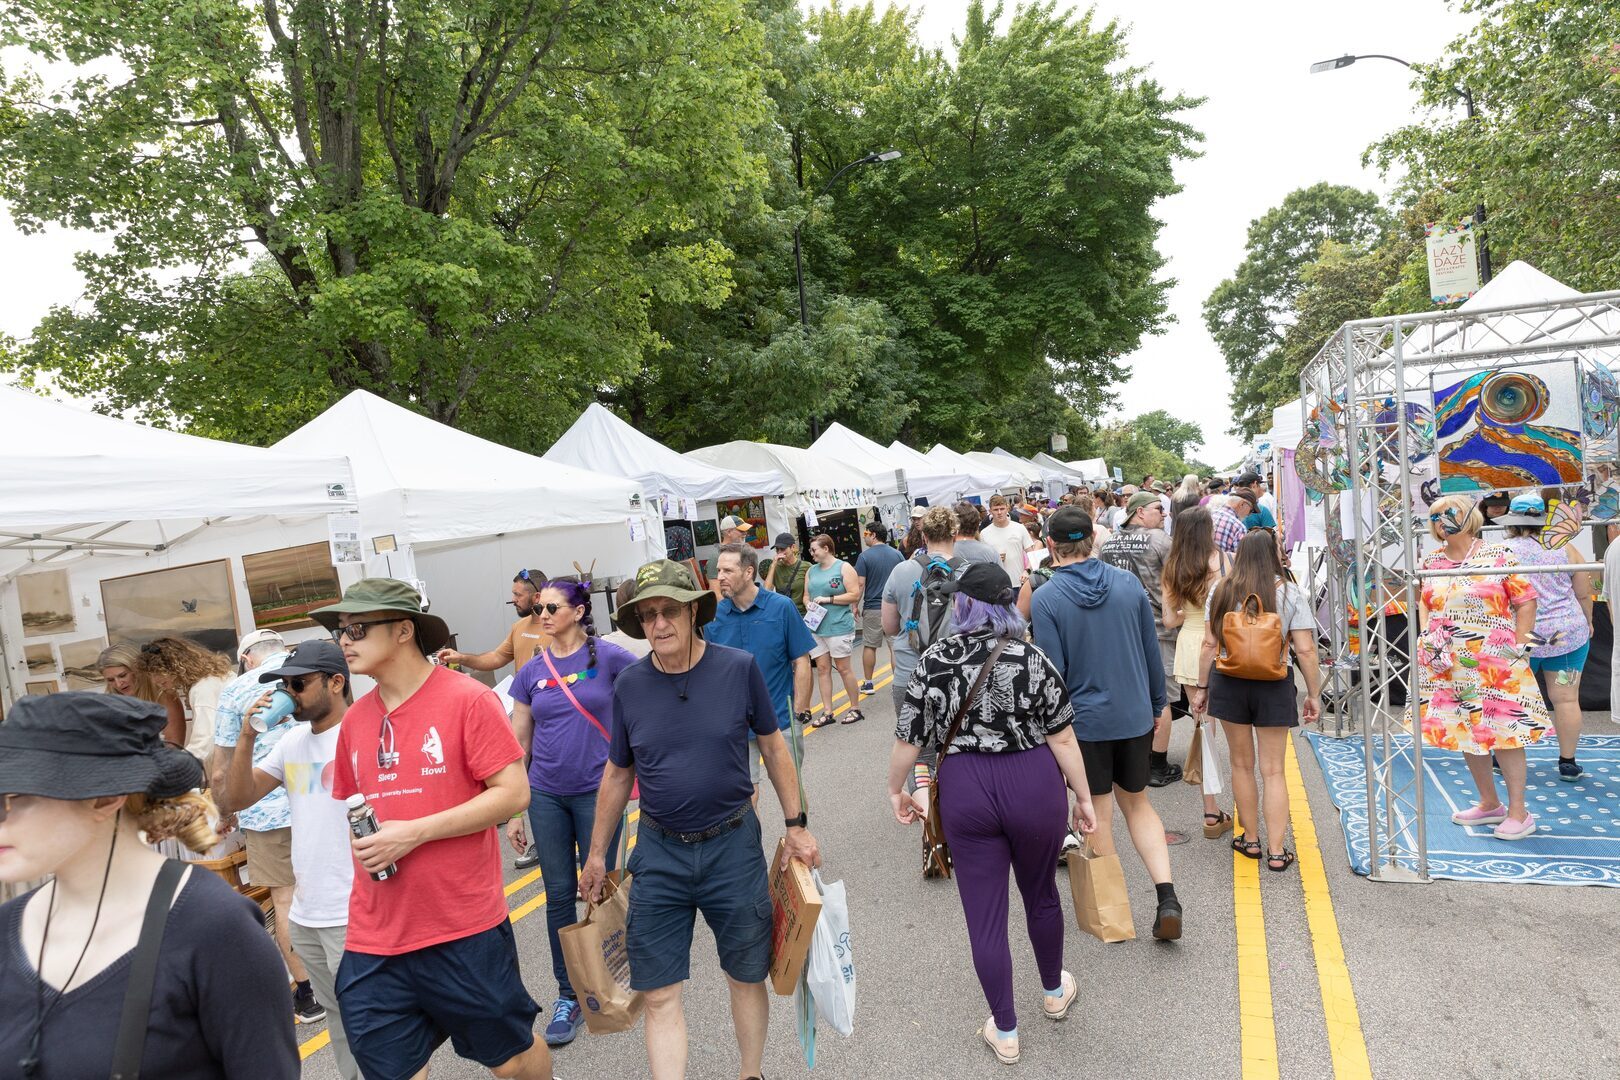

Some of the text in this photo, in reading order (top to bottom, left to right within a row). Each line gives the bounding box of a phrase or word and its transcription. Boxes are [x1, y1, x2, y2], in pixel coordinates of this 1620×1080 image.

[1433, 244, 1464, 258] LAZY
[1434, 254, 1467, 268] DAZE
[421, 765, 447, 776] Howl
[402, 787, 423, 795] Housing
